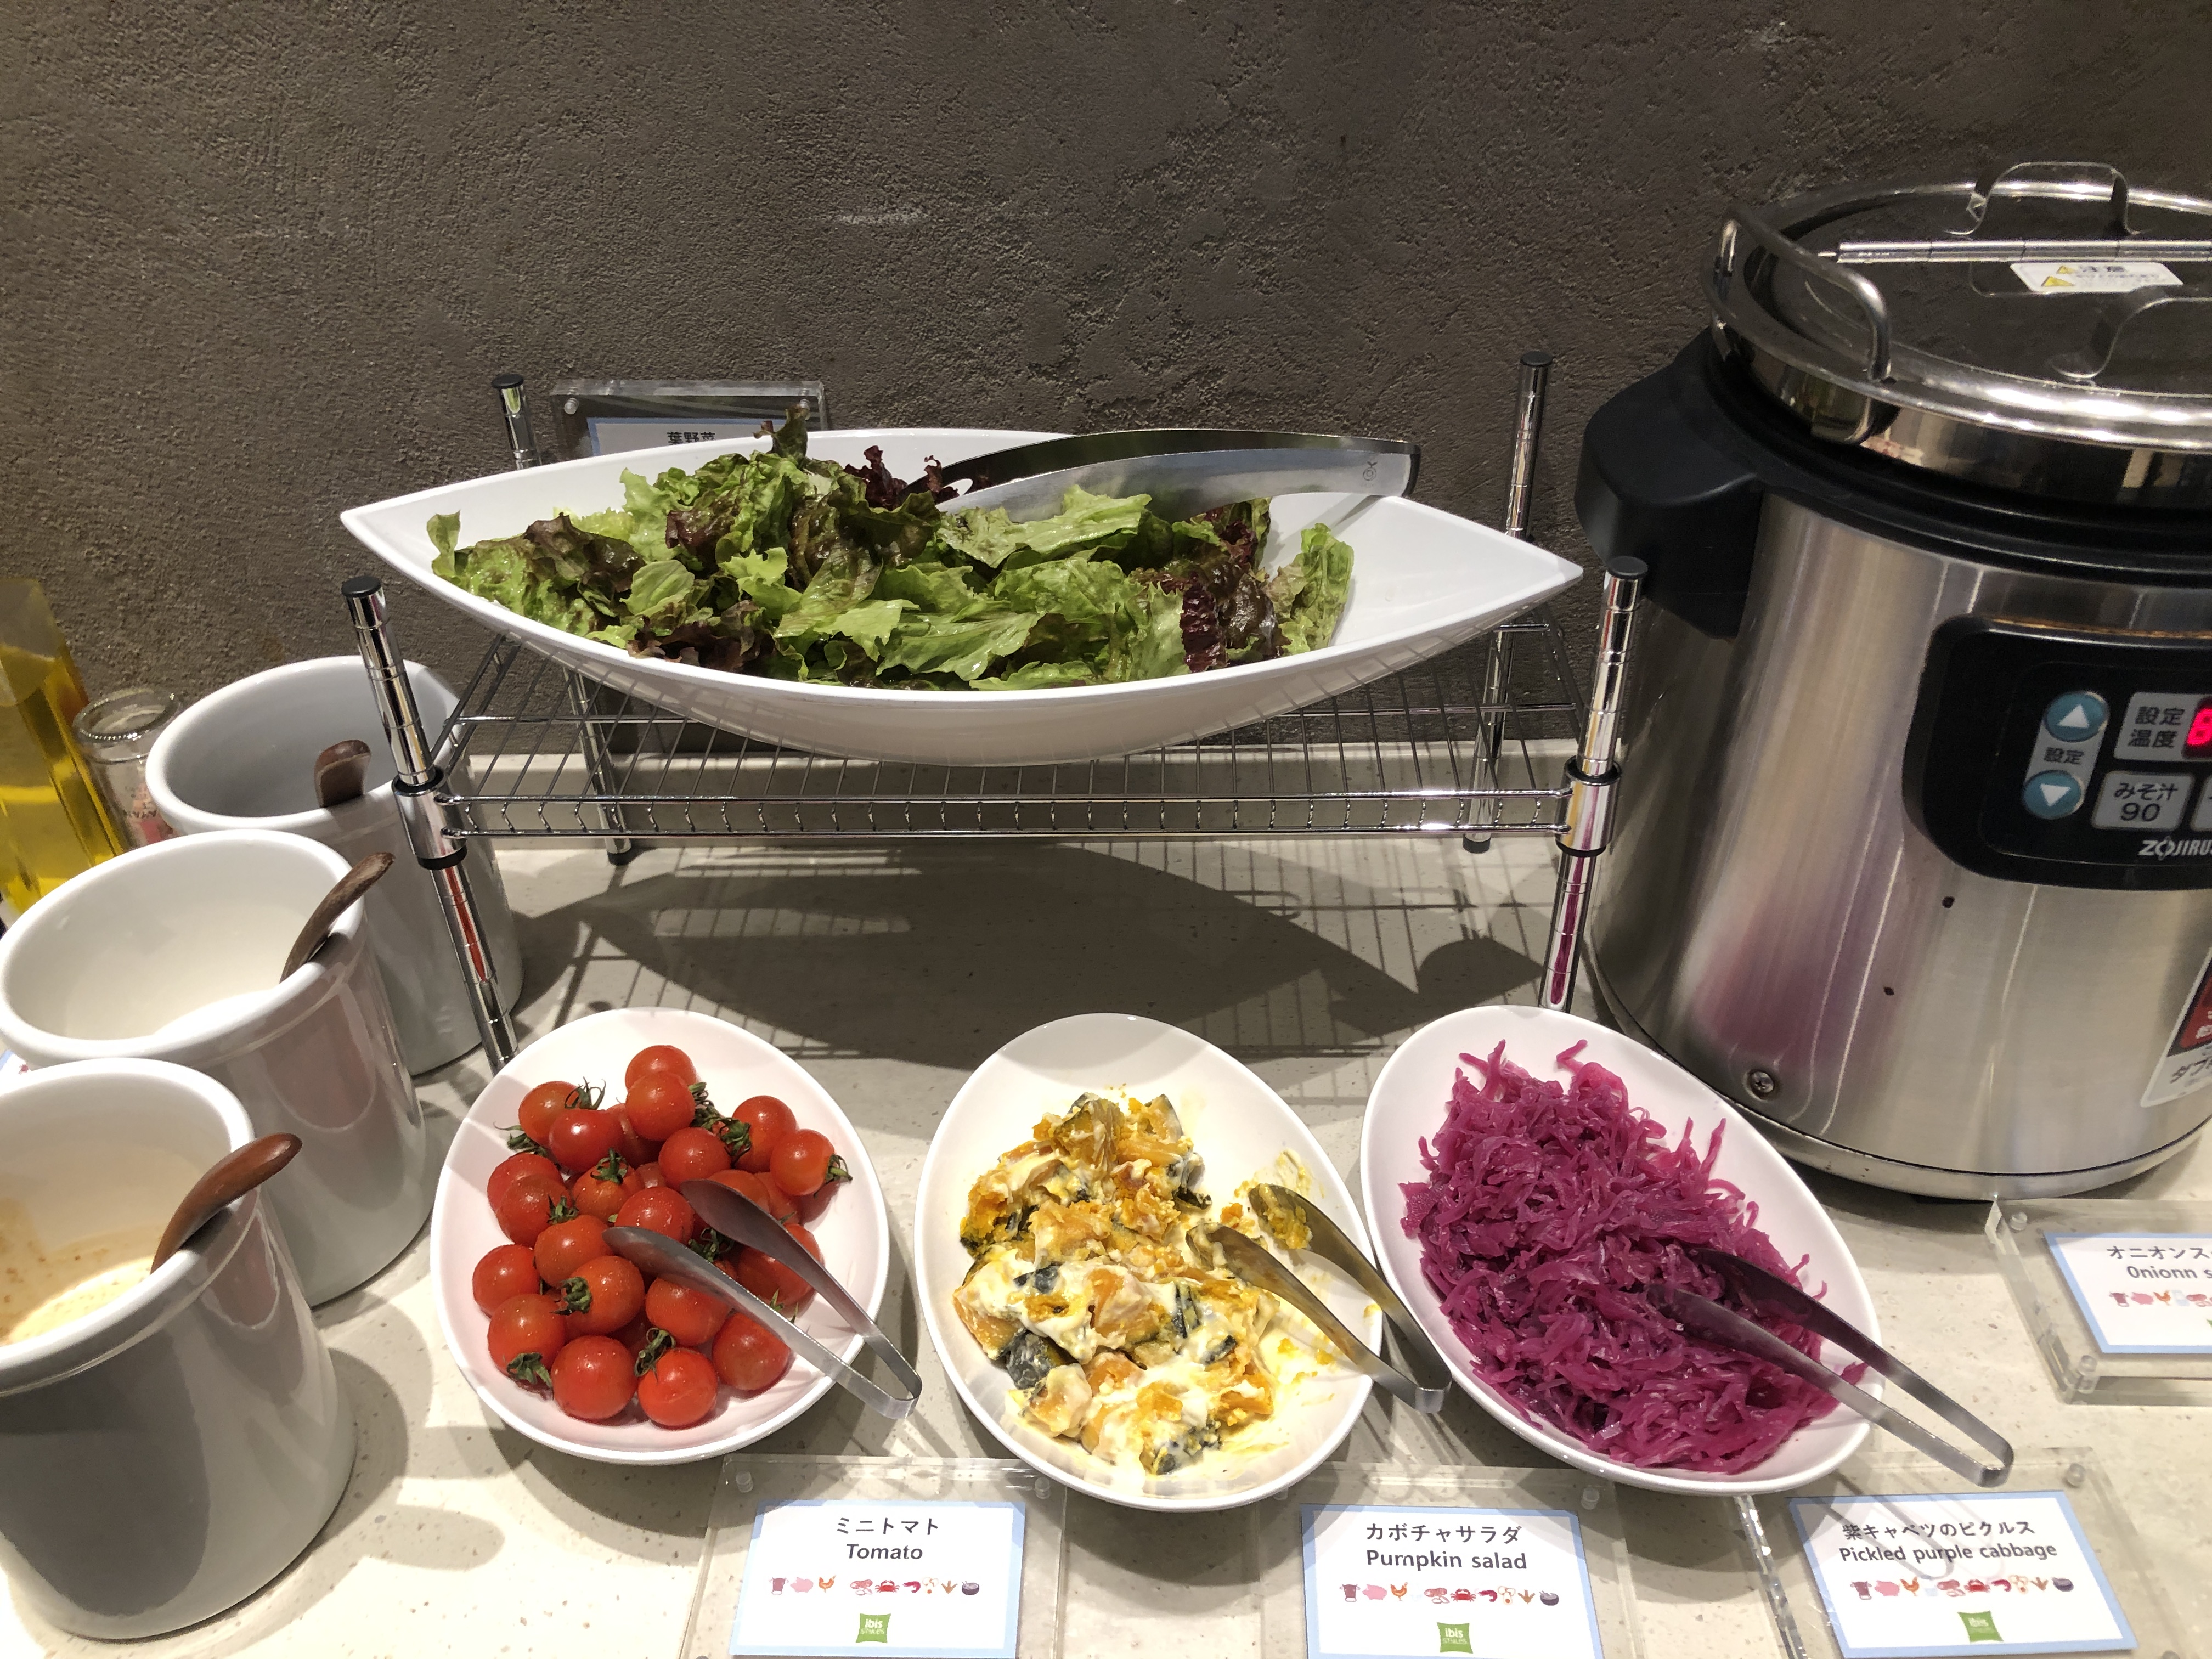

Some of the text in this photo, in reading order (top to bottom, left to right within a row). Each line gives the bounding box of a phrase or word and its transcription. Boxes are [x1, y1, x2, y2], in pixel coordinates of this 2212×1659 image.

[2135, 706, 2185, 725] 設定
[2128, 729, 2177, 748] 温度
[2044, 747, 2084, 765] 設定
[2114, 782, 2178, 800] みそ汁
[2120, 802, 2160, 821] 90
[2138, 836, 2212, 861] ZOJIRU
[2107, 1245, 2212, 1260] オニオンス
[837, 1517, 938, 1536] ミニトマト
[1366, 1523, 1522, 1544] カボチャサラダ
[846, 1543, 923, 1560] Tomato
[1366, 1549, 1527, 1571] Pumpkin salad
[1839, 1543, 2058, 1564] Pickled purple cabbage
[1444, 1628, 1464, 1638] ibis
